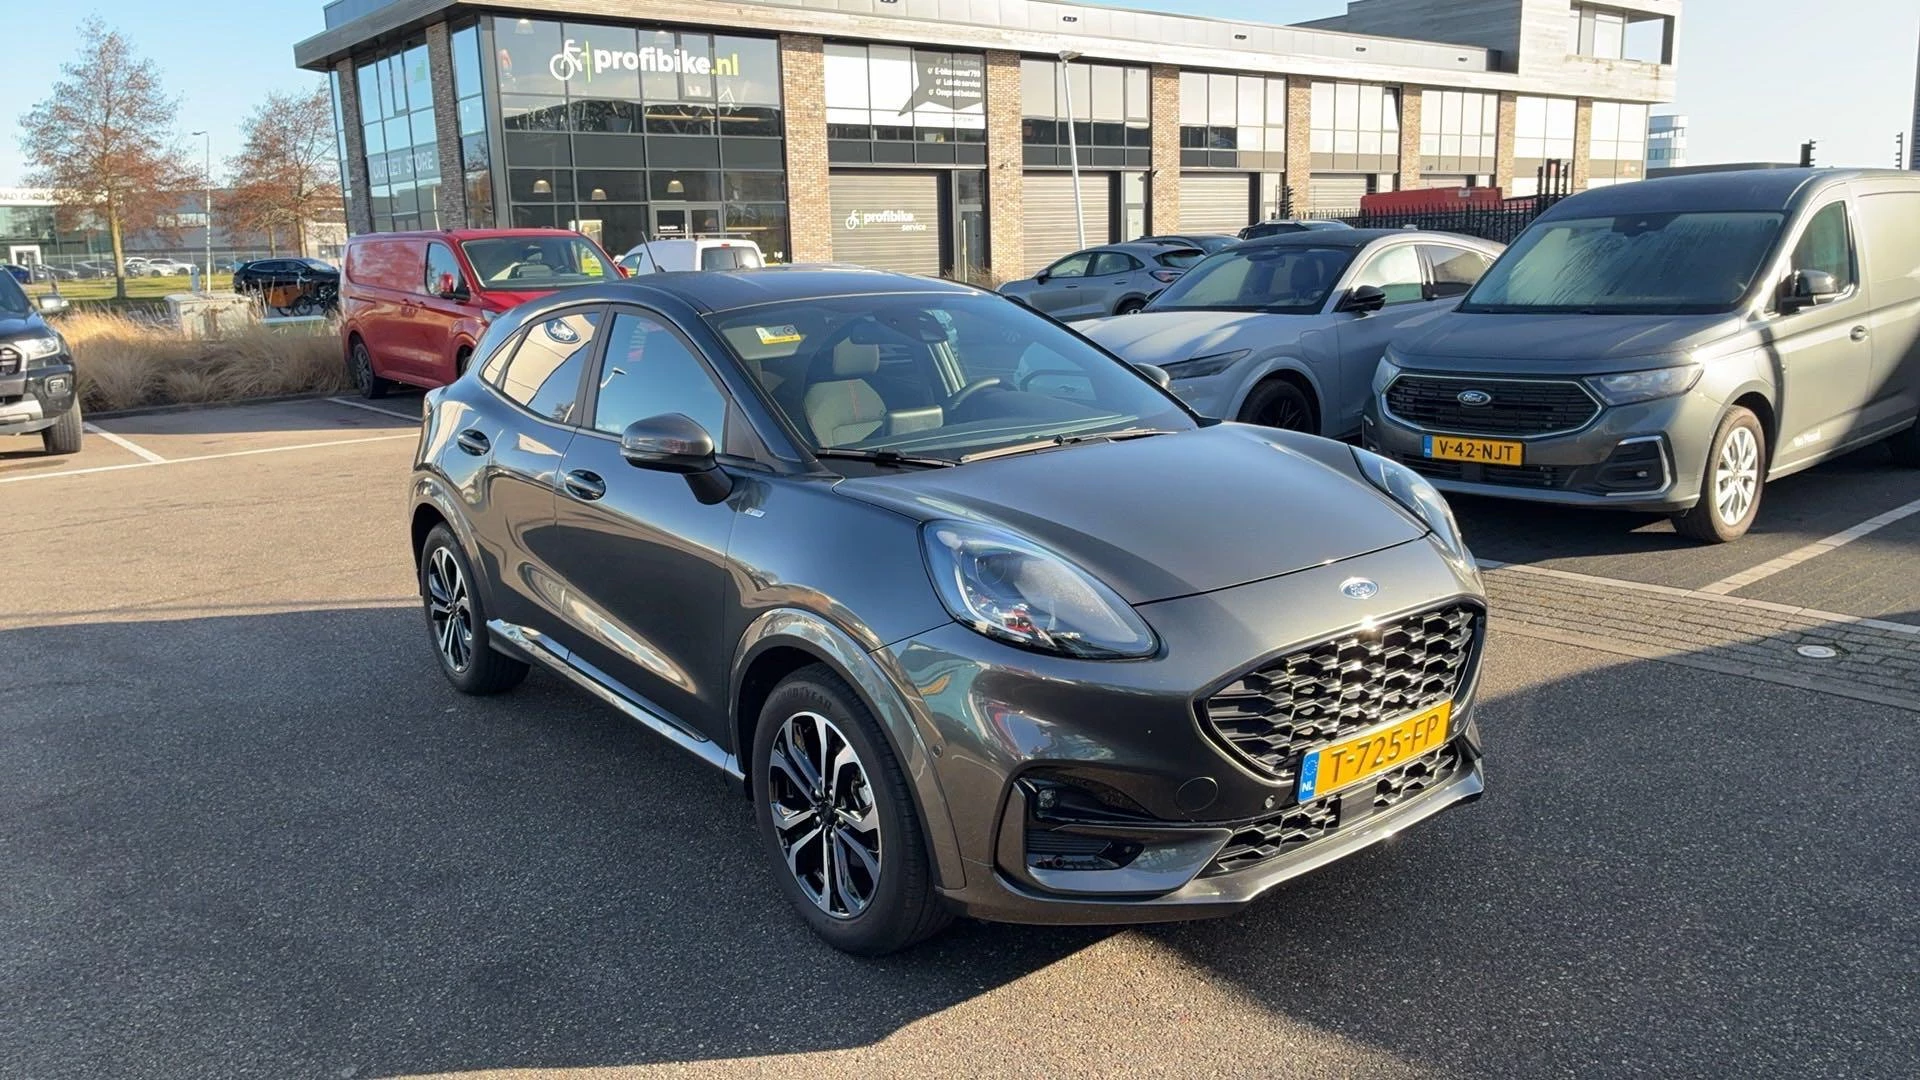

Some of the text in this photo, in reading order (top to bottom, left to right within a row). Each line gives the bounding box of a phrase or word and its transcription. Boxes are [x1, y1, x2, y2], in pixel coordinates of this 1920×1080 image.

[594, 46, 740, 76] profibike.nl
[901, 222, 927, 232] service
[1438, 440, 1514, 462] V-42-NJT
[1302, 713, 1440, 793] NL T-725-FP
